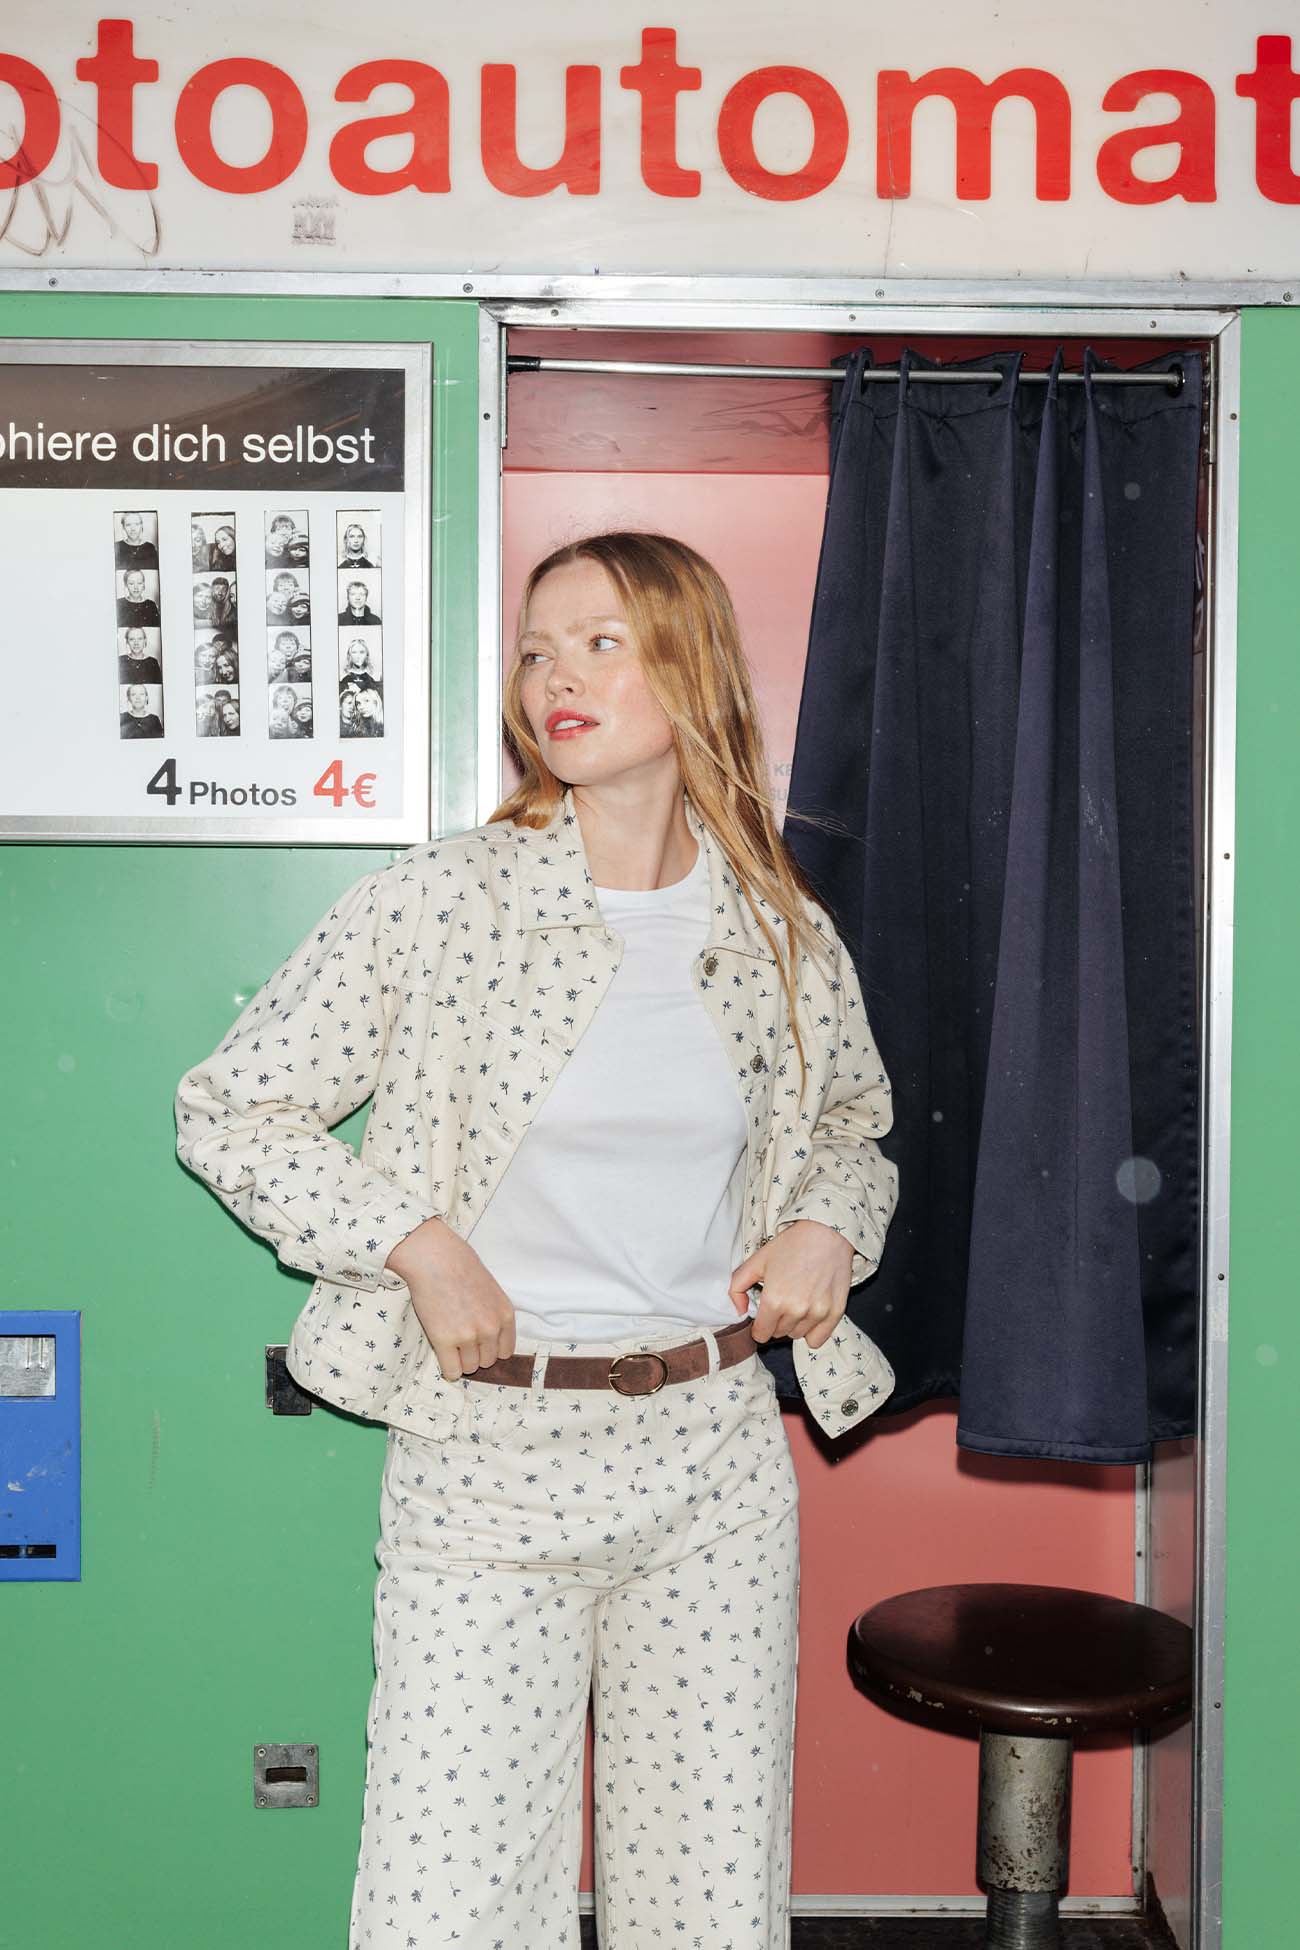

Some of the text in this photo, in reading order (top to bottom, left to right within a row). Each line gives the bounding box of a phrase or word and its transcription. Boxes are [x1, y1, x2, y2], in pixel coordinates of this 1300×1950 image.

[0, 421, 376, 464] hiere dich selbst
[146, 758, 183, 806] 4
[189, 781, 297, 806] Photos
